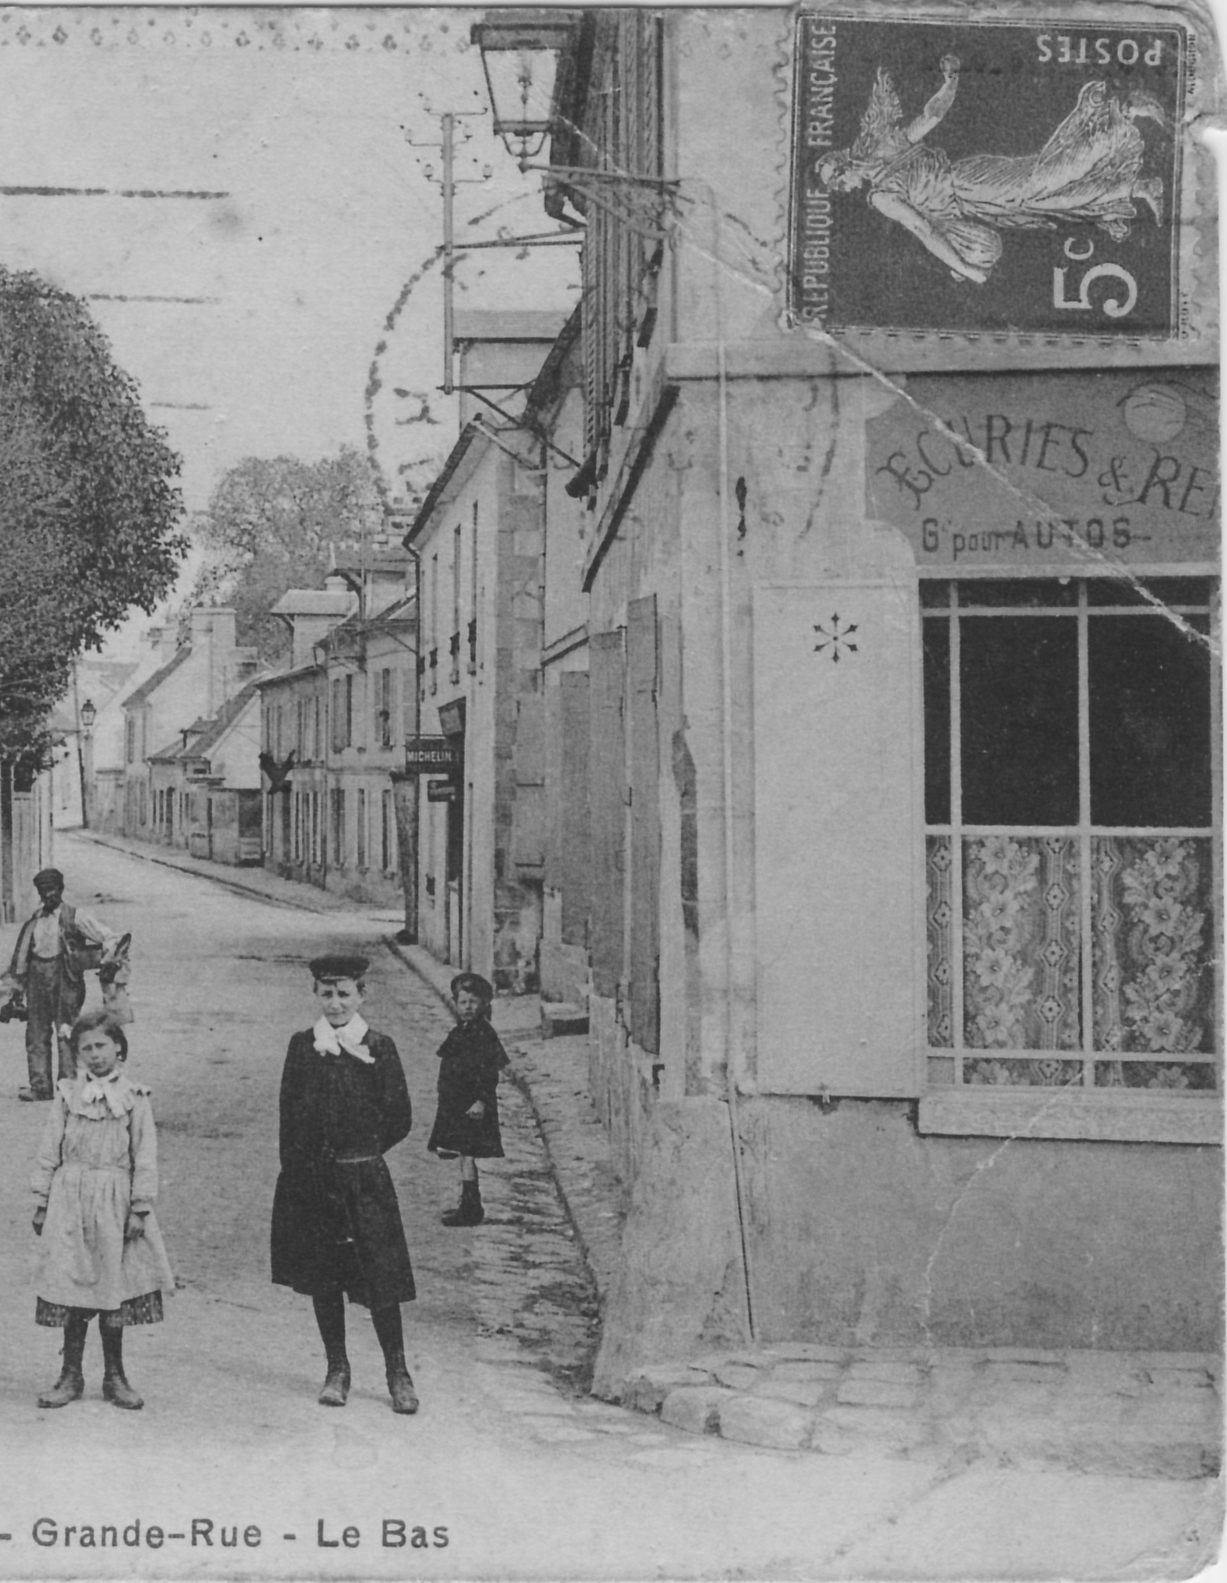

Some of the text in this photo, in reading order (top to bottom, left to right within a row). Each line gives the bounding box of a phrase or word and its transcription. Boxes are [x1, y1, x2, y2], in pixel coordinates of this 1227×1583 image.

[1036, 34, 1162, 66] POSTES
[807, 24, 838, 147] FRANÇAISE
[1104, 447, 1218, 520] RE
[406, 750, 452, 762] MICHELIN
